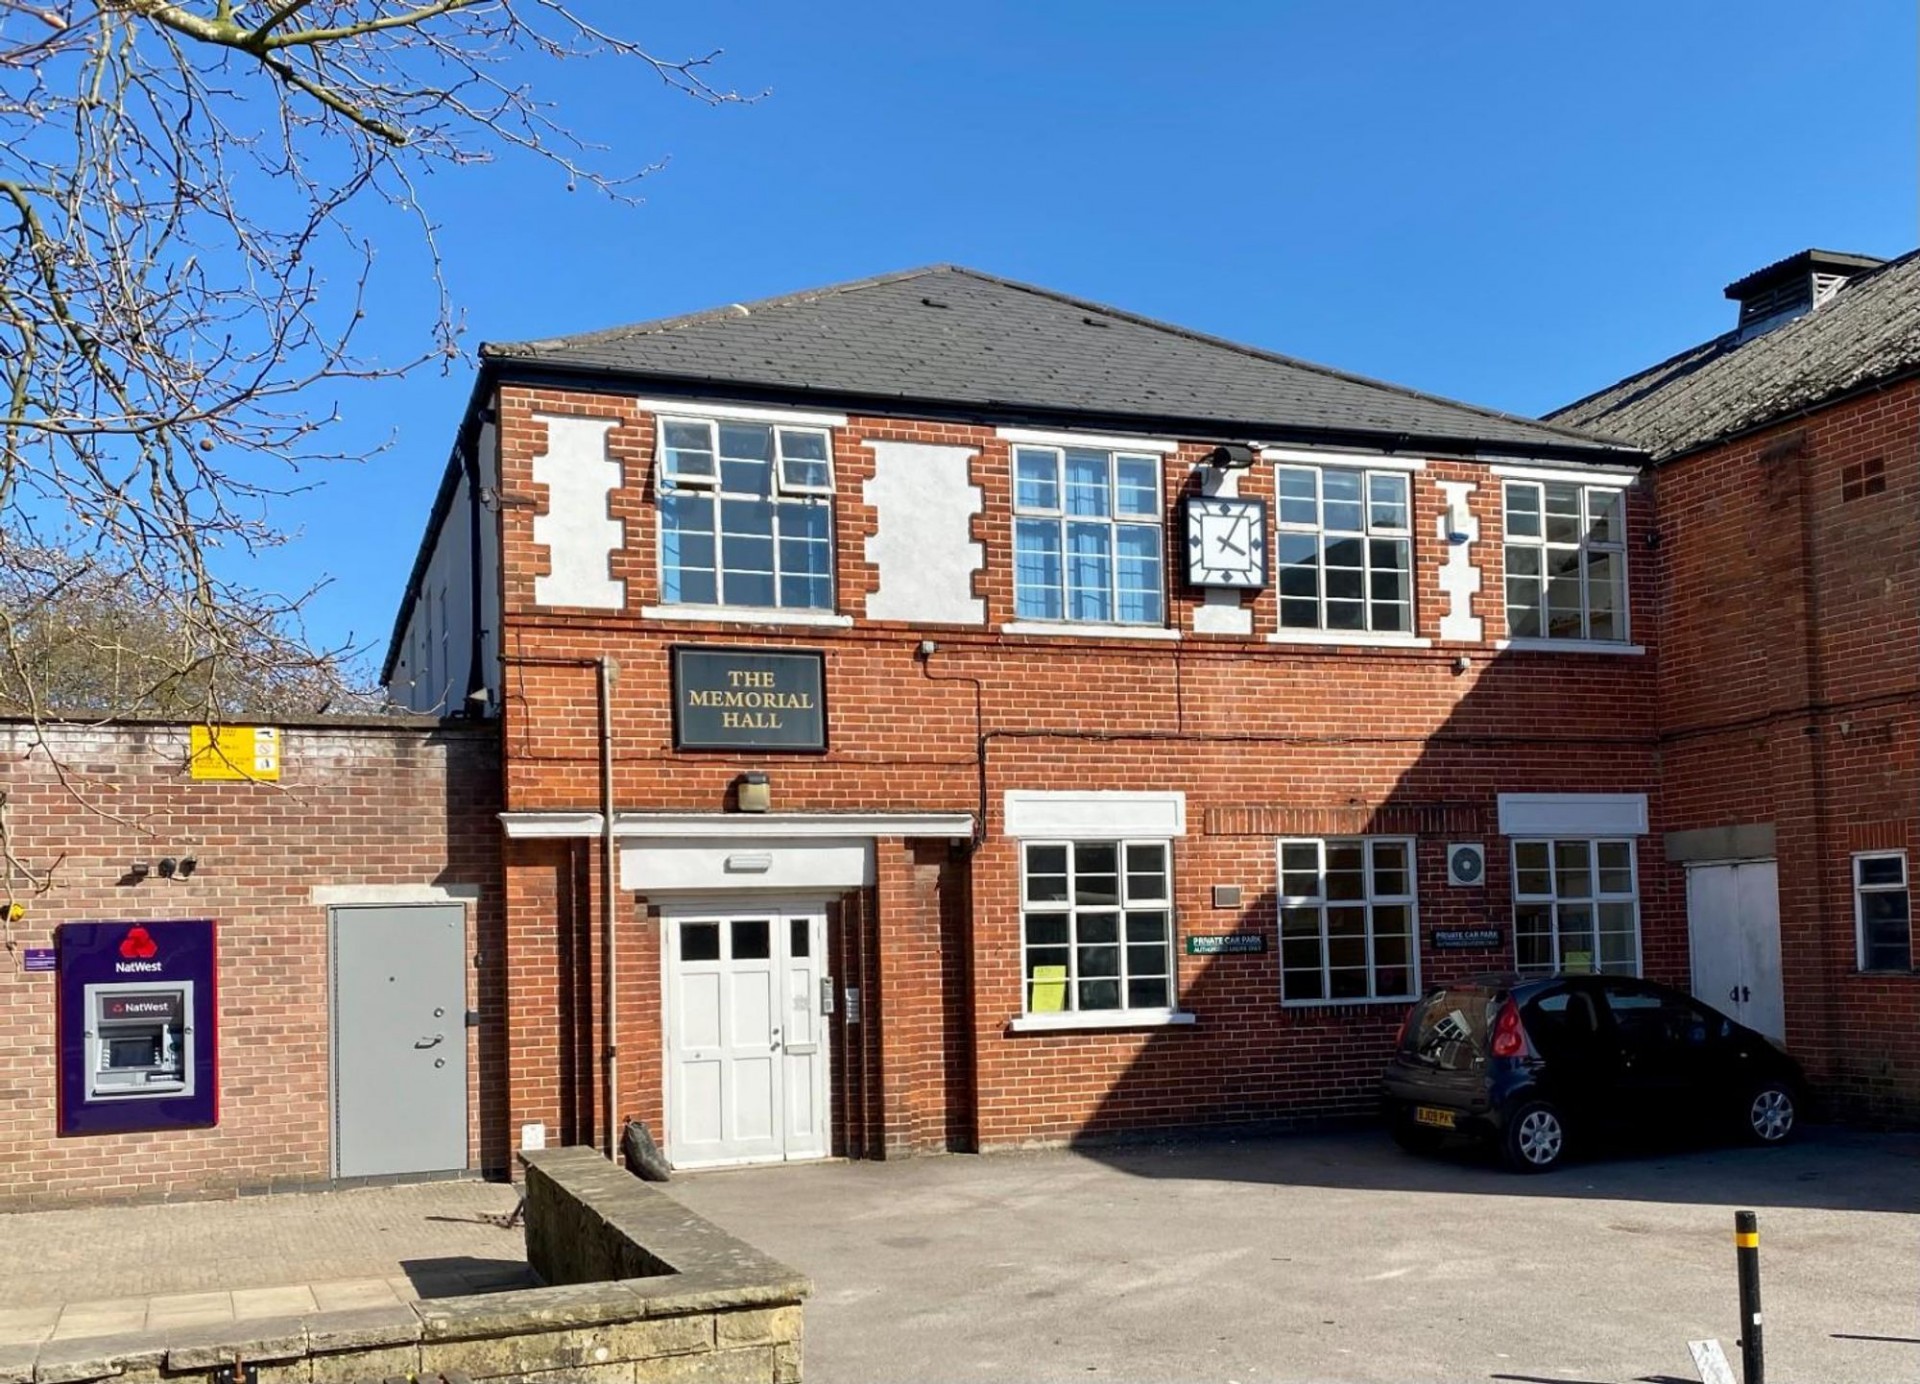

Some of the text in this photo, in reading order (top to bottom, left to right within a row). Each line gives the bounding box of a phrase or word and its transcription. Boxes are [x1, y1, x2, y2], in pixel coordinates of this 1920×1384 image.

[728, 670, 776, 688] THE
[688, 689, 814, 709] MEMORIAL
[722, 712, 783, 729] HALL
[1193, 935, 1261, 946] PRIVATE CAR PARK
[115, 961, 162, 973] NatWest
[125, 1002, 169, 1012] NatWest
